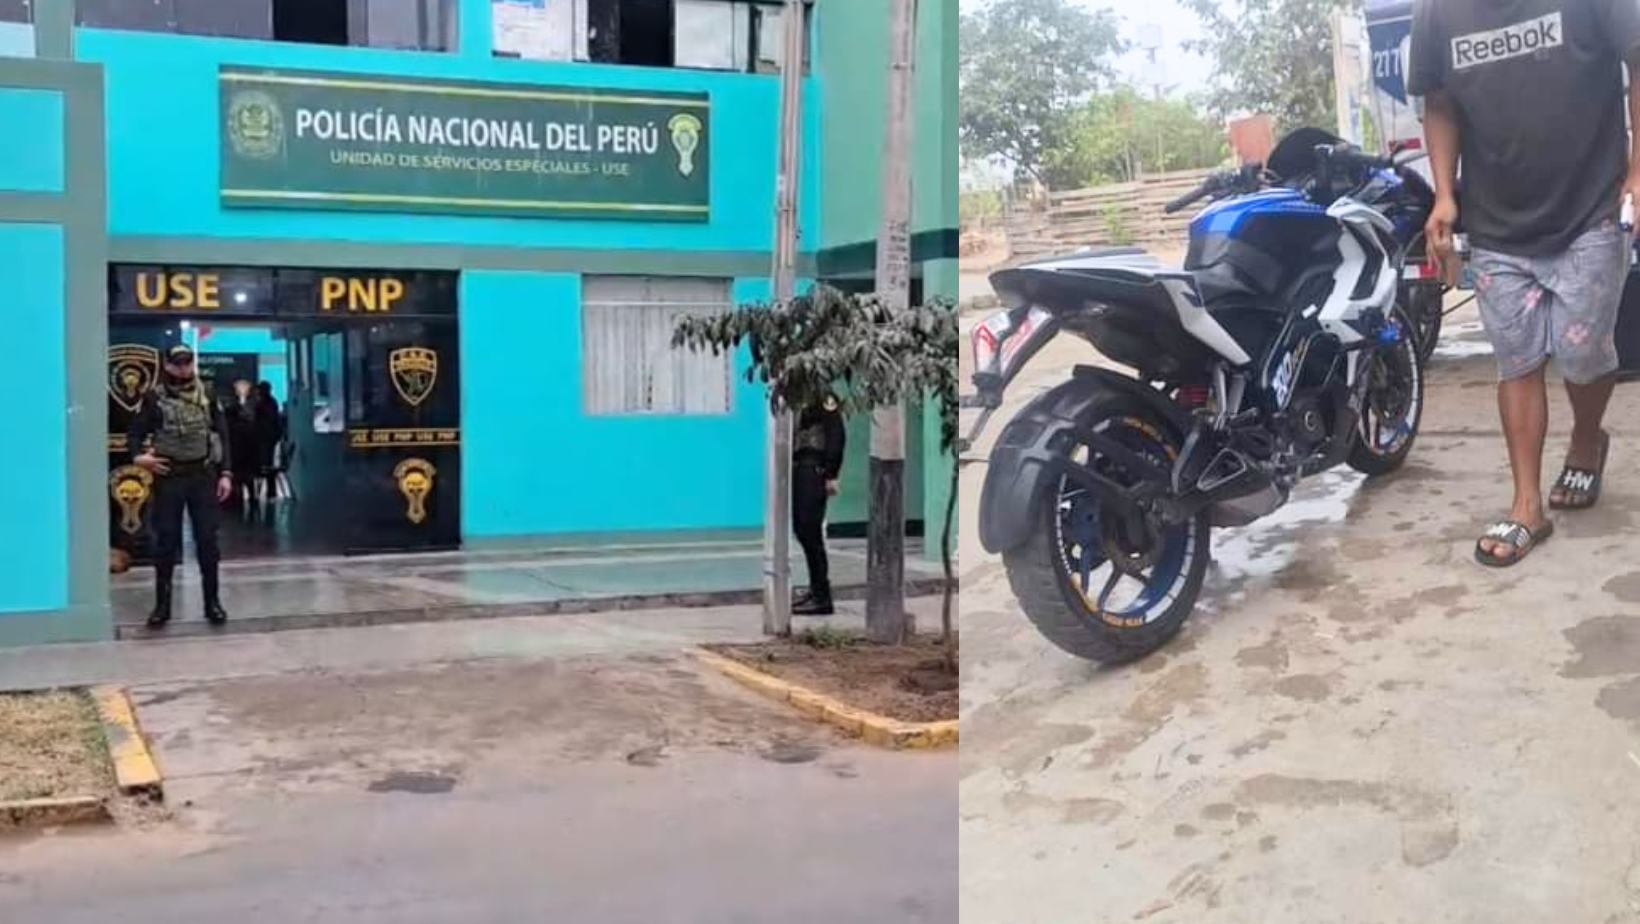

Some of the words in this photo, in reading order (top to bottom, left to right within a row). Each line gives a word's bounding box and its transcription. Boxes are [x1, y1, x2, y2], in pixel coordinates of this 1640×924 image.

[1453, 20, 1557, 65] Reebok
[296, 107, 402, 142] POLICÍA
[409, 115, 540, 149] NACIONAL
[546, 122, 592, 152] DEL
[598, 121, 658, 154] PERÚ
[330, 149, 395, 167] UNIDAD
[399, 153, 420, 168] DE
[422, 155, 502, 171] SERVICIOS
[505, 158, 591, 174] ESPECIALES
[602, 162, 630, 176] USE
[136, 272, 220, 308] USE
[321, 277, 404, 311] PNP
